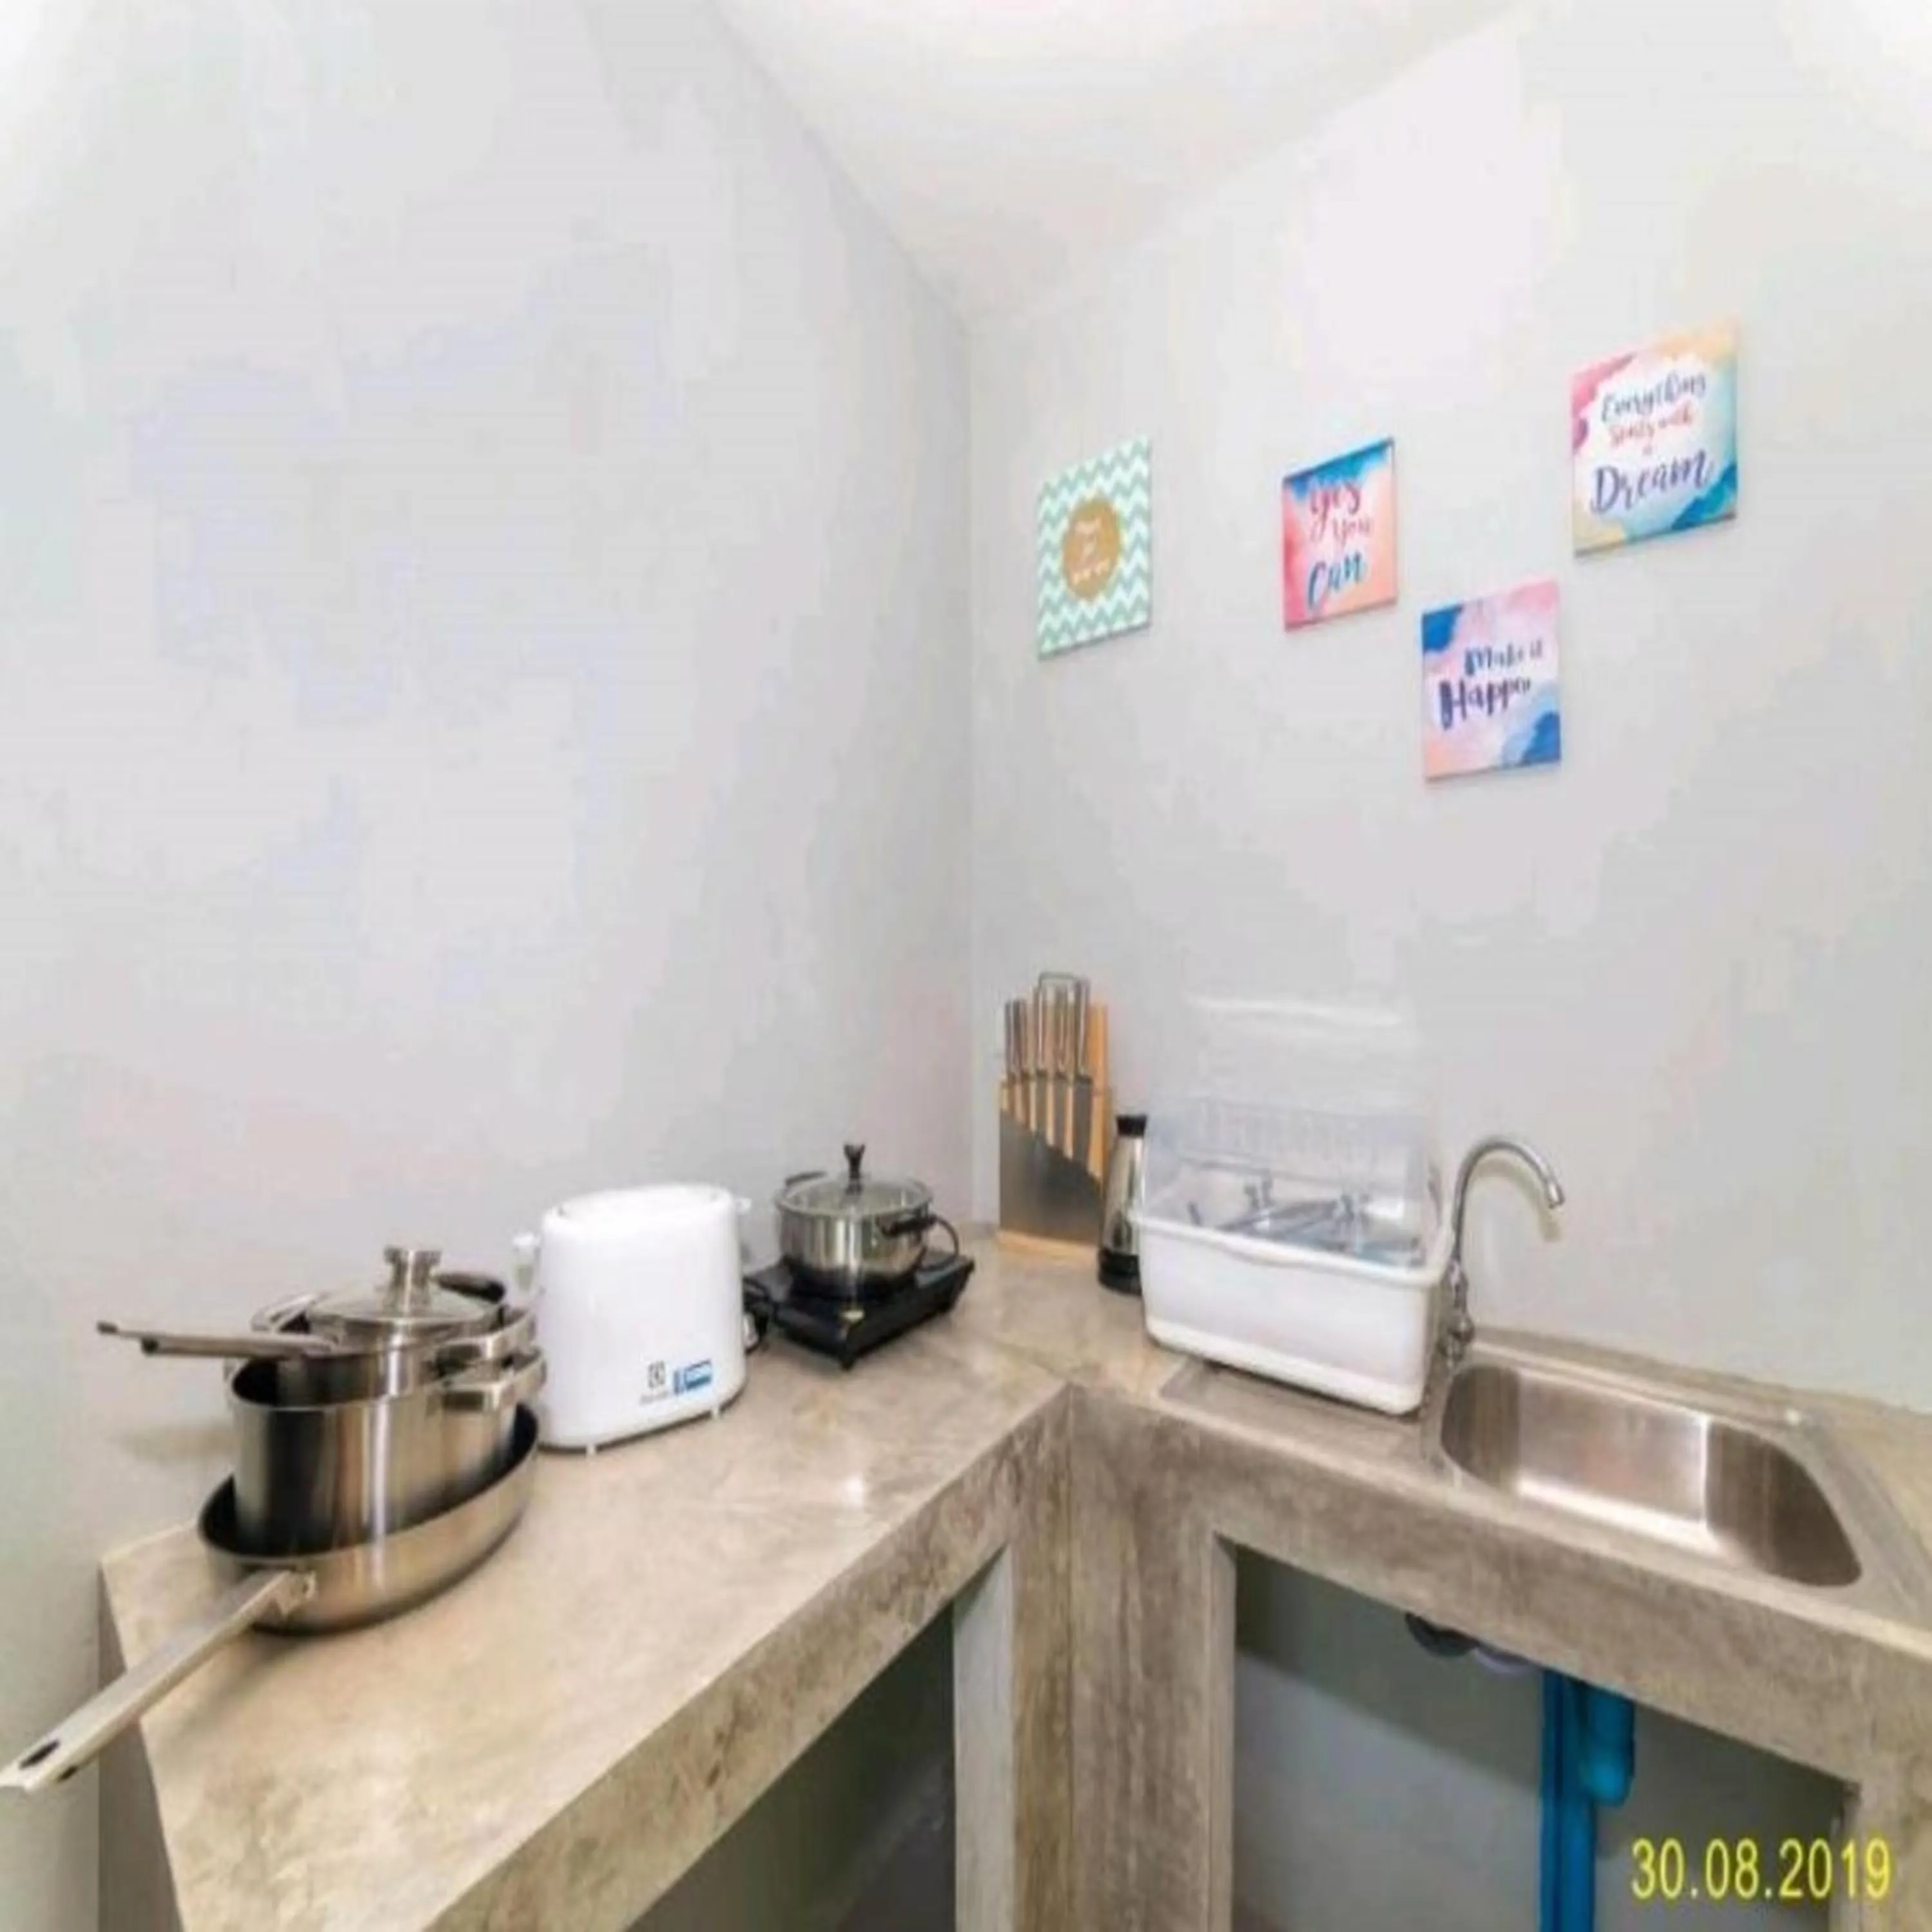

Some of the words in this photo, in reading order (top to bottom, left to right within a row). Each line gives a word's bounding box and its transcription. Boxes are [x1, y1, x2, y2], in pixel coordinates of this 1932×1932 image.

[1592, 449, 1714, 515] Dream
[1464, 641, 1524, 676] Make
[1530, 639, 1543, 659] it
